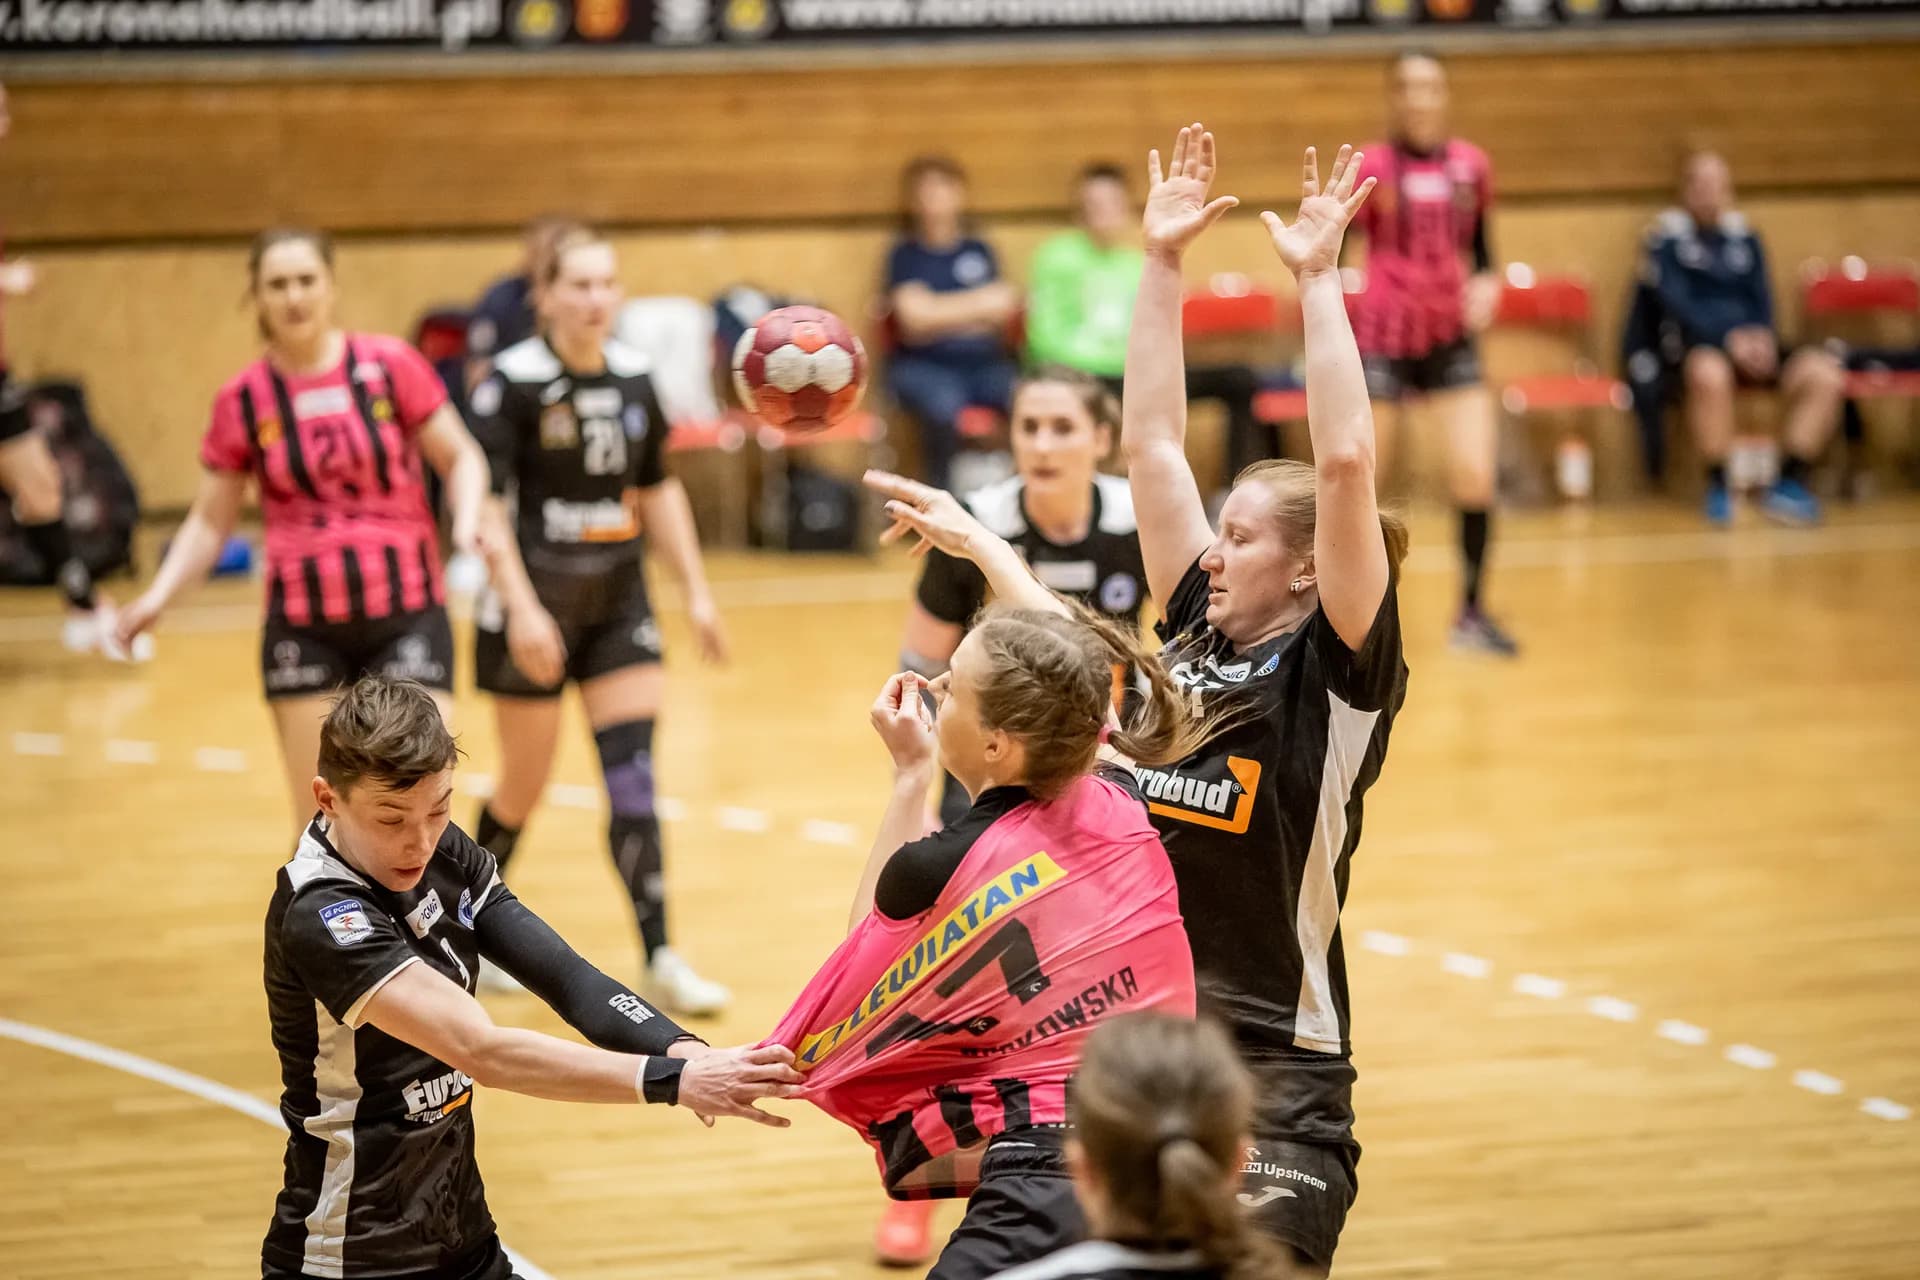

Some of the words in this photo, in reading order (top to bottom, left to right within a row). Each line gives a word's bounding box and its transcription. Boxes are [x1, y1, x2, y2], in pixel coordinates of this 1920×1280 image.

[0, 0, 501, 51] .koronahandball.pl
[848, 863, 1041, 1032] LEWIATAN
[1263, 1162, 1327, 1192] Upstream
